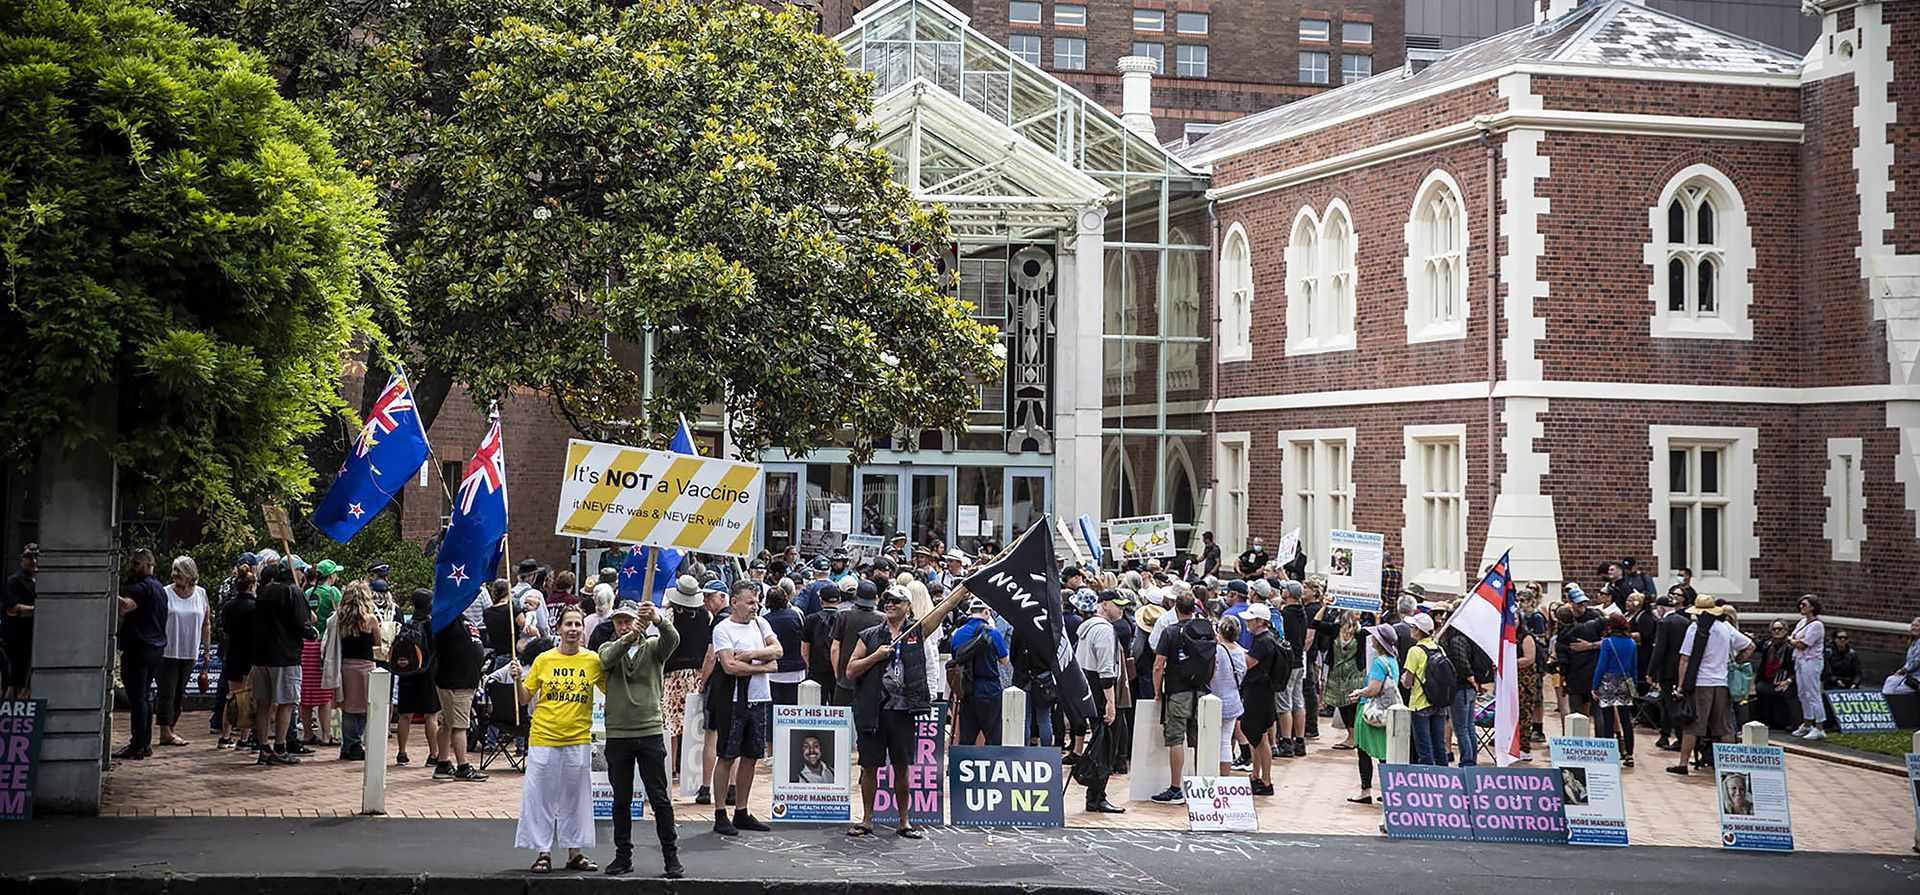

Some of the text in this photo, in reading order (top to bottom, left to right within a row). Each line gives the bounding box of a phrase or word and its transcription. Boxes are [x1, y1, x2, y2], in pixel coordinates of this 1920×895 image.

[573, 465, 750, 504] It's NOT a Vaccine
[573, 498, 741, 530] it NEVER was & NEVER will be
[554, 668, 586, 678] NOT A
[1829, 692, 1885, 702] IS THIS THE
[778, 708, 844, 718] LOST HIS LIFE
[1833, 701, 1889, 714] FUTURE
[1836, 713, 1892, 722] YOU WANT
[1553, 738, 1615, 748] VACCINE INJURED
[1562, 748, 1608, 757] TACHYCARDIA
[1717, 745, 1780, 755] VACCINE INJURED
[1718, 754, 1781, 766] PERICARDITIS
[960, 760, 1052, 783] STAND
[1387, 772, 1464, 790] JACINDA
[1476, 774, 1555, 793] JACINDA
[1184, 780, 1252, 799] Pure BLOOD
[966, 788, 1050, 812] UP NZ
[1213, 796, 1230, 809] OR
[1386, 792, 1401, 807] IS
[1407, 793, 1444, 808] OUT
[1473, 794, 1562, 812] IS OUT OF
[1188, 811, 1224, 824] Bloody
[1476, 814, 1565, 832] CONTROL!
